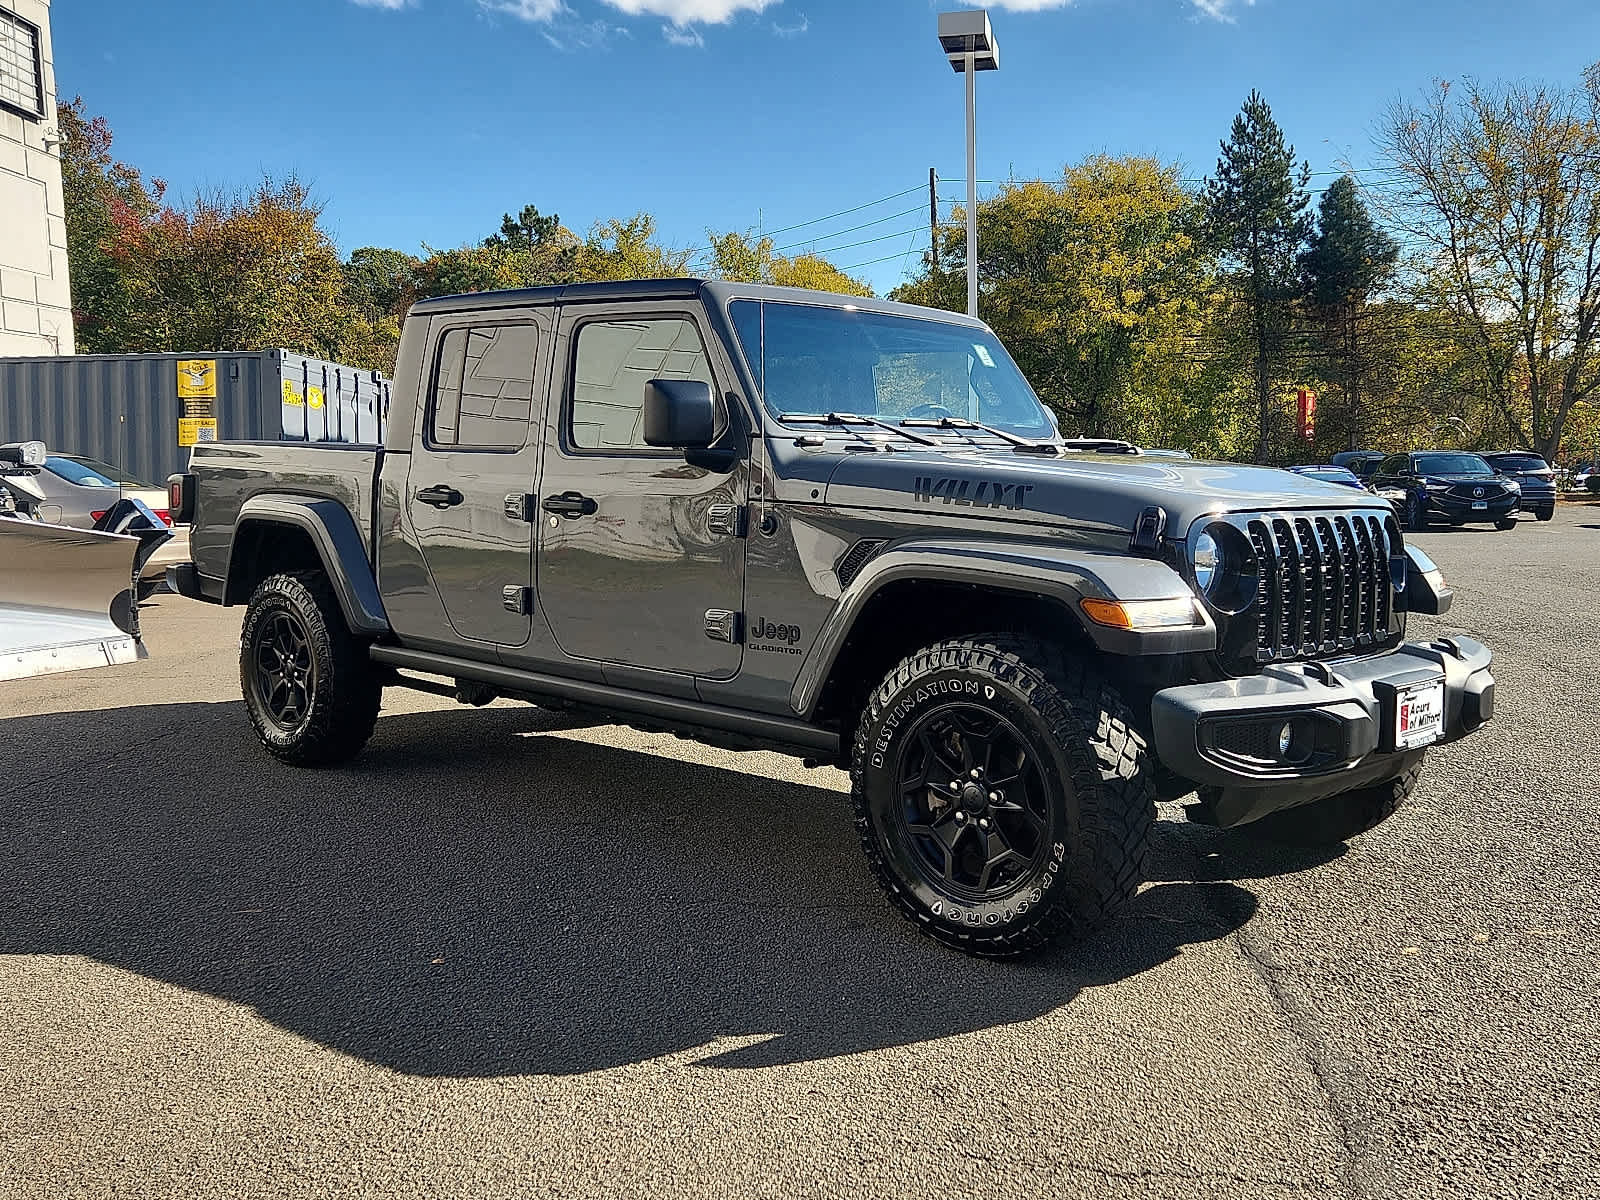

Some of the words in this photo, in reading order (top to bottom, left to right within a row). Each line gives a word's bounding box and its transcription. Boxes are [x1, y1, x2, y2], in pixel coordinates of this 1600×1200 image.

[913, 475, 1035, 511] WILLYS
[751, 615, 801, 645] Jeep
[748, 643, 803, 656] GLADIATOR
[871, 679, 980, 769] DESTINATION
[1409, 701, 1431, 717] Acura
[1409, 716, 1418, 730] of
[1418, 709, 1442, 728] Milford
[947, 841, 1065, 927] Firestone
